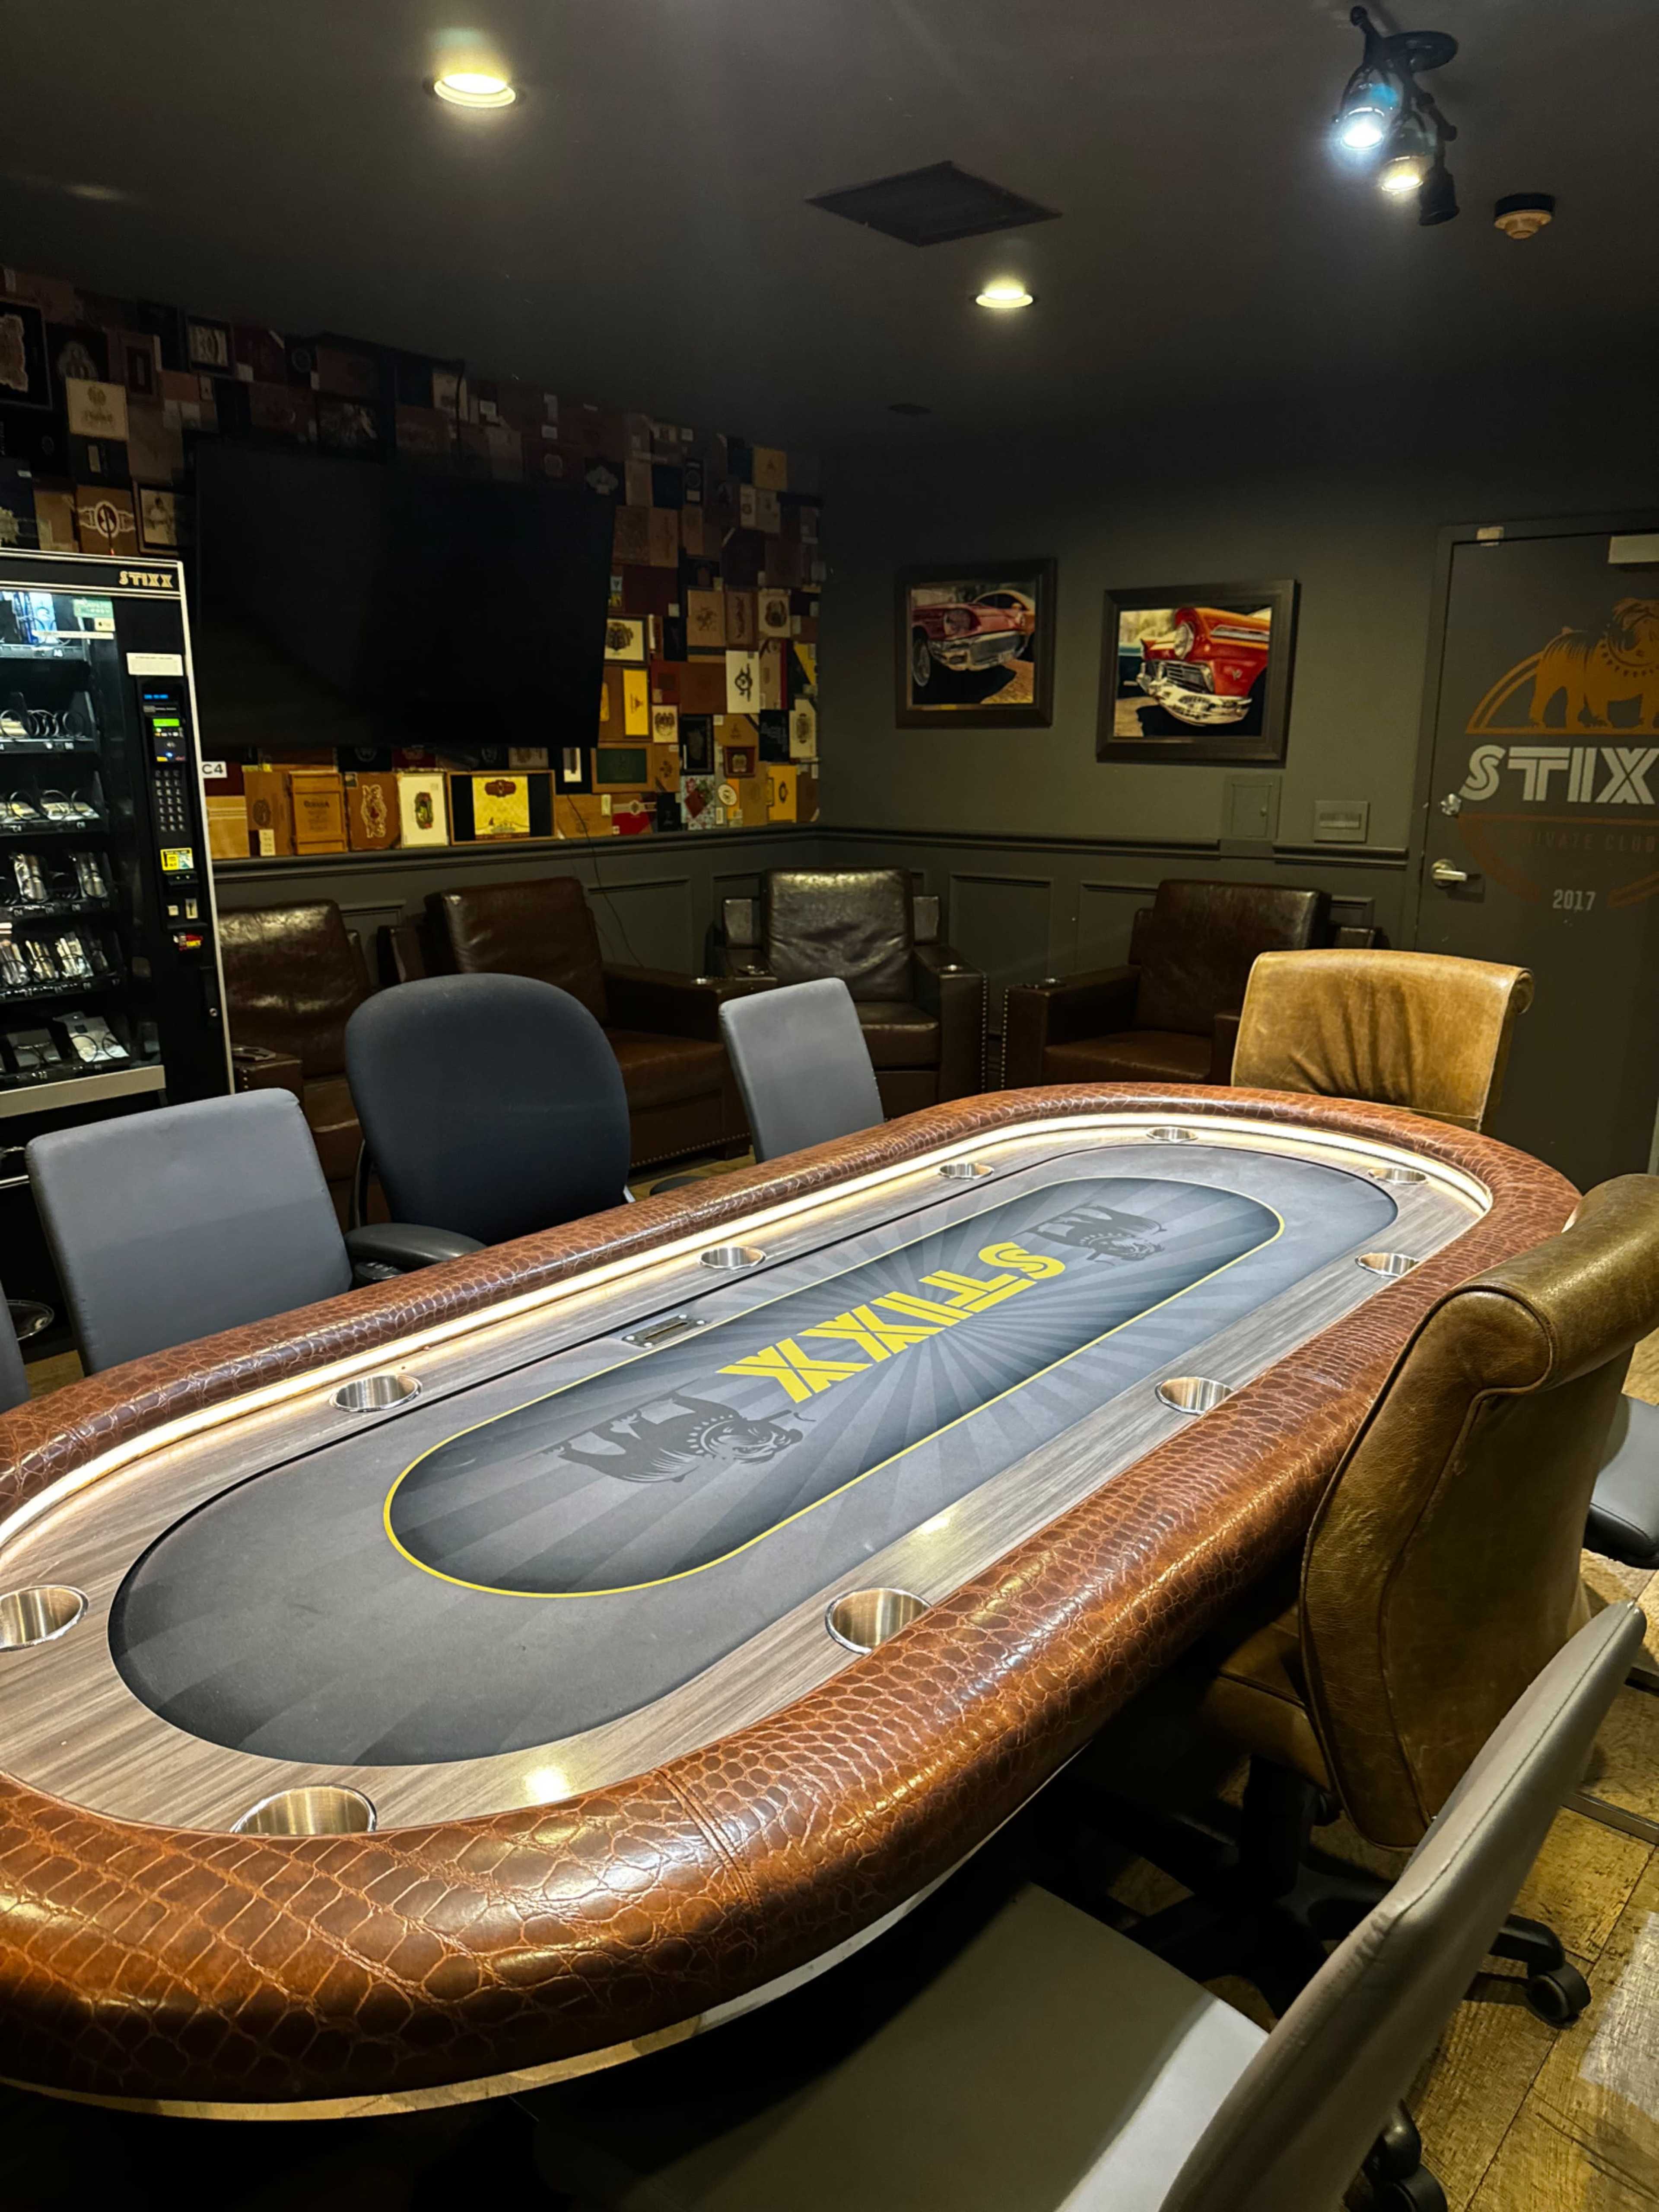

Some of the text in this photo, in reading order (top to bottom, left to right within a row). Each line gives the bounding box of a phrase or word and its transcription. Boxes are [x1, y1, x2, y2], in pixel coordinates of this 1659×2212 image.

[119, 571, 173, 587] STIXX
[202, 764, 223, 774] C4
[1552, 889, 1596, 911] 2017
[716, 1242, 1065, 1403] STIXX
